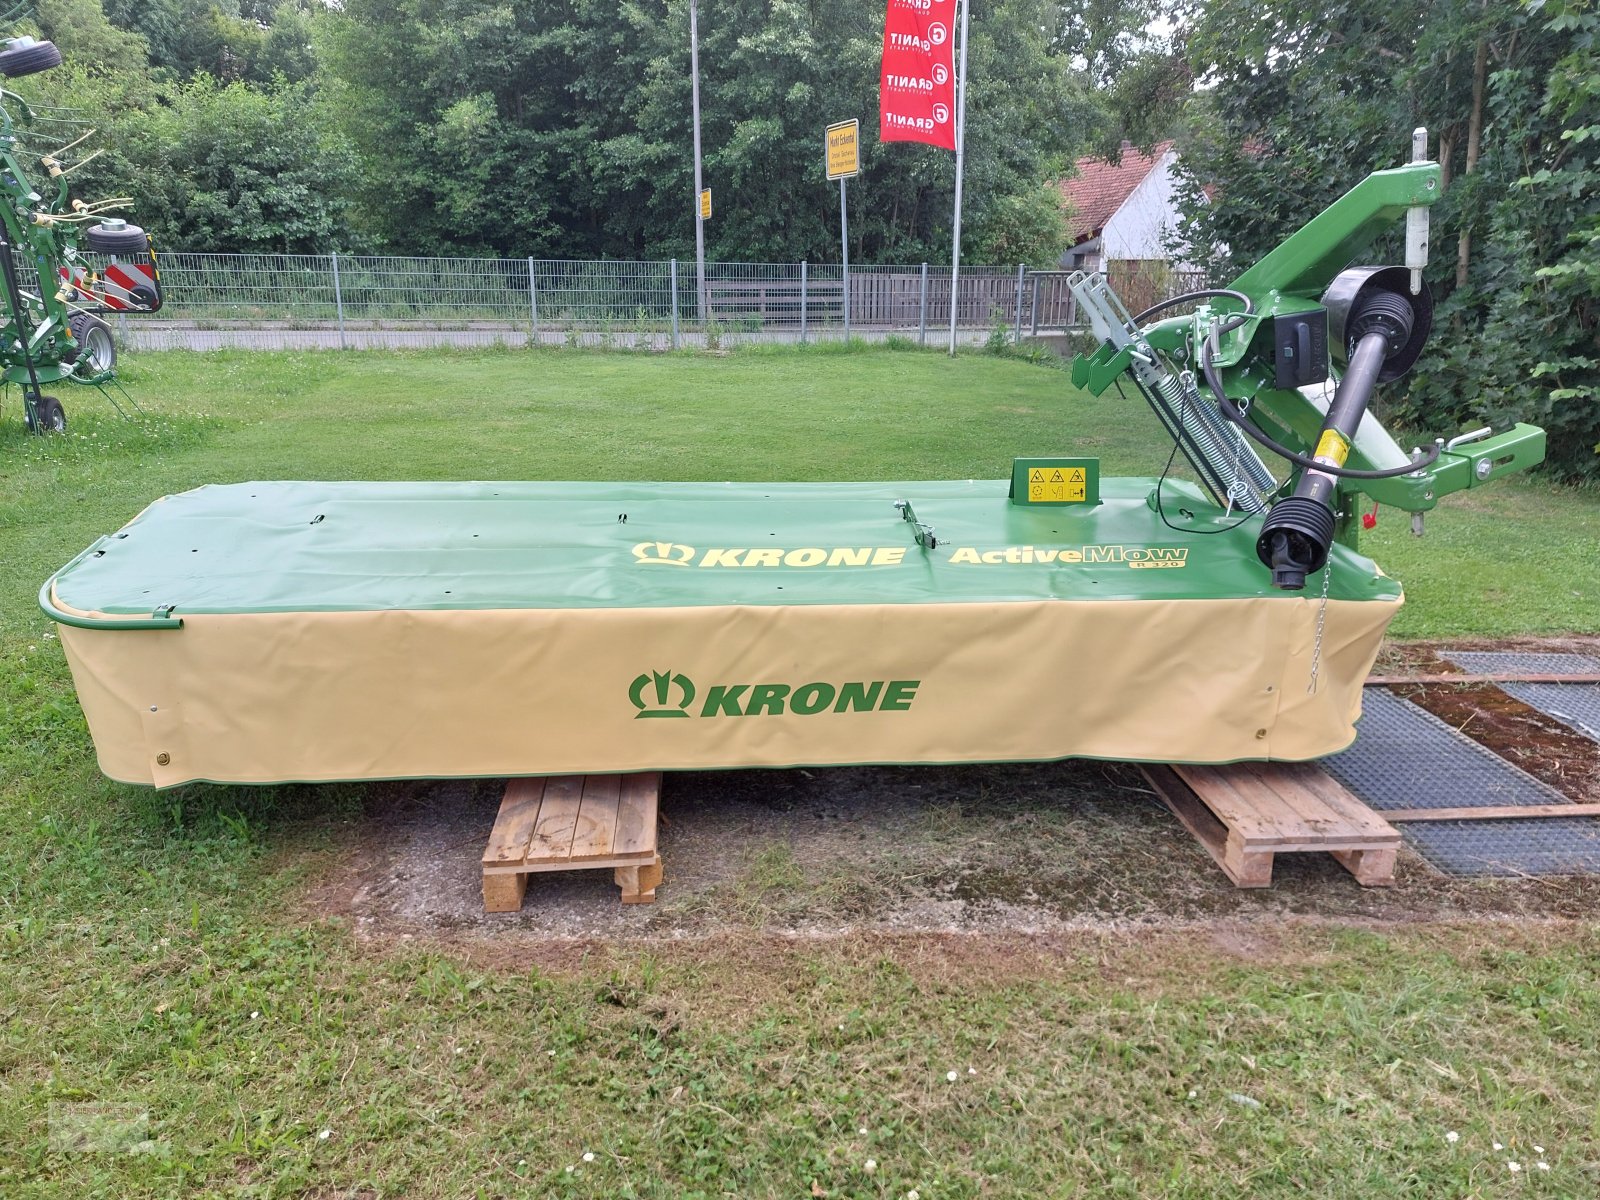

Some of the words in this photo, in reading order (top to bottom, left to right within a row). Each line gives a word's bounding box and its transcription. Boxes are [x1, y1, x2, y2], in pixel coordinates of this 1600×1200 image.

[698, 547, 907, 567] KRONE
[948, 545, 1188, 564] ActiveMow
[700, 680, 921, 717] KRONE
